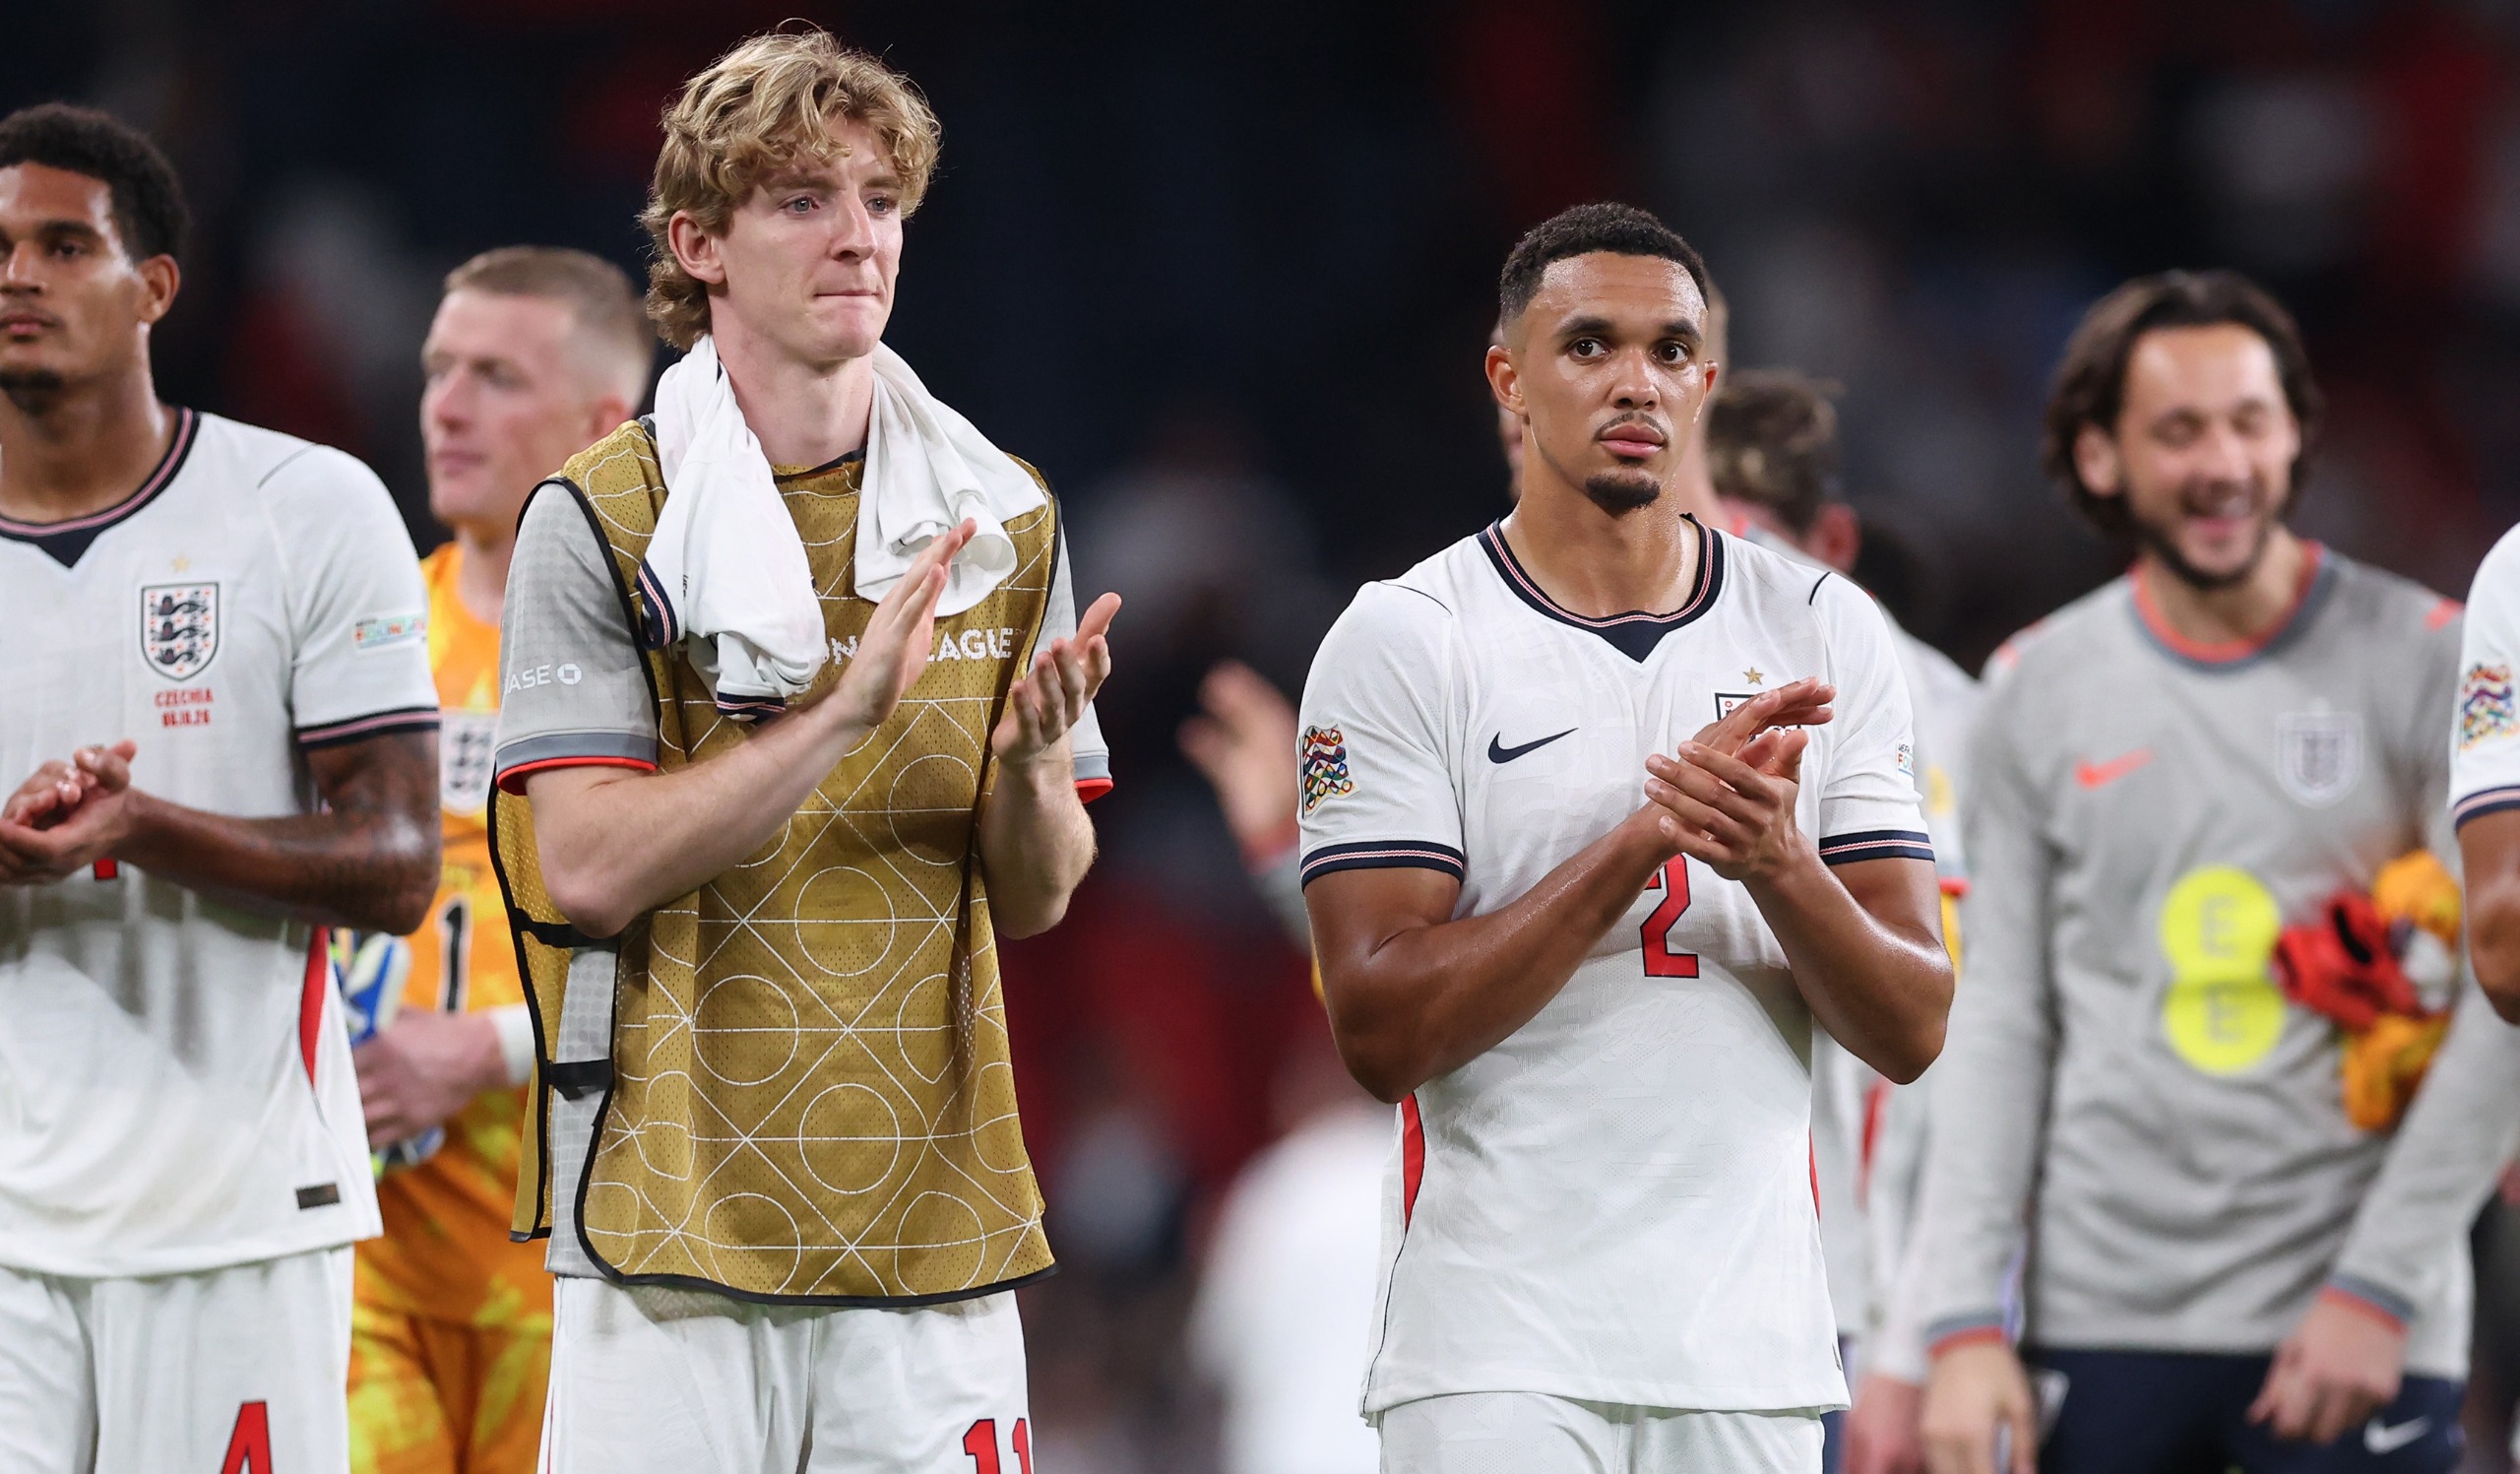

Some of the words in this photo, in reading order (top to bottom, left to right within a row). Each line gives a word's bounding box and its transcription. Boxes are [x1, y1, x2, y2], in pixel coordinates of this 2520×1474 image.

[926, 626, 1014, 663] AGUE
[155, 686, 215, 707] CZECHIA
[1639, 852, 1700, 979] 2
